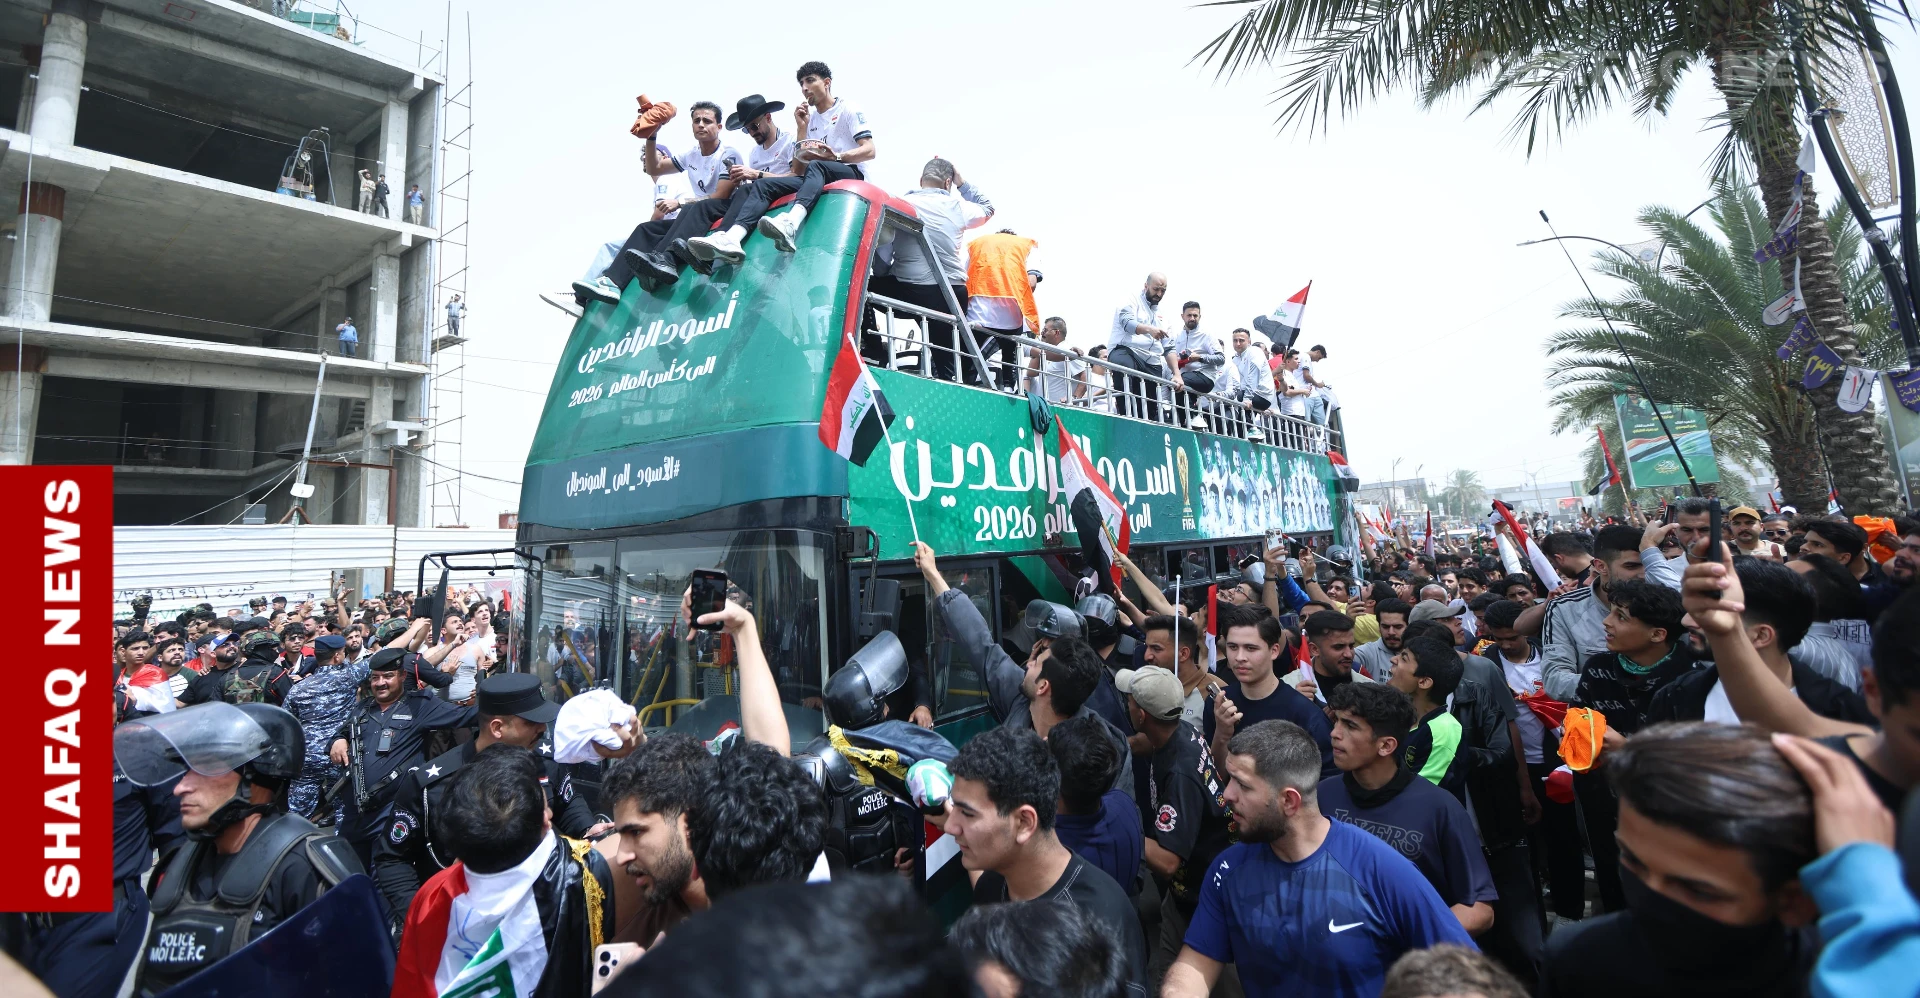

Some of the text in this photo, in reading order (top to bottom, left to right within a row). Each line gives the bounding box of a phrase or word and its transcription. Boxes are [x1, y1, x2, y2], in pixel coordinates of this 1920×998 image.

[578, 290, 740, 374] أسود الرافدين
[608, 369, 649, 398] العالم
[647, 358, 690, 389] كأس
[568, 383, 603, 408] 2026
[974, 505, 1037, 542] 2026
[1182, 518, 1196, 531] FIFA
[863, 791, 882, 805] POLICE
[857, 804, 872, 816] MOI
[160, 932, 197, 948] POLICE
[150, 946, 169, 962] MOI
